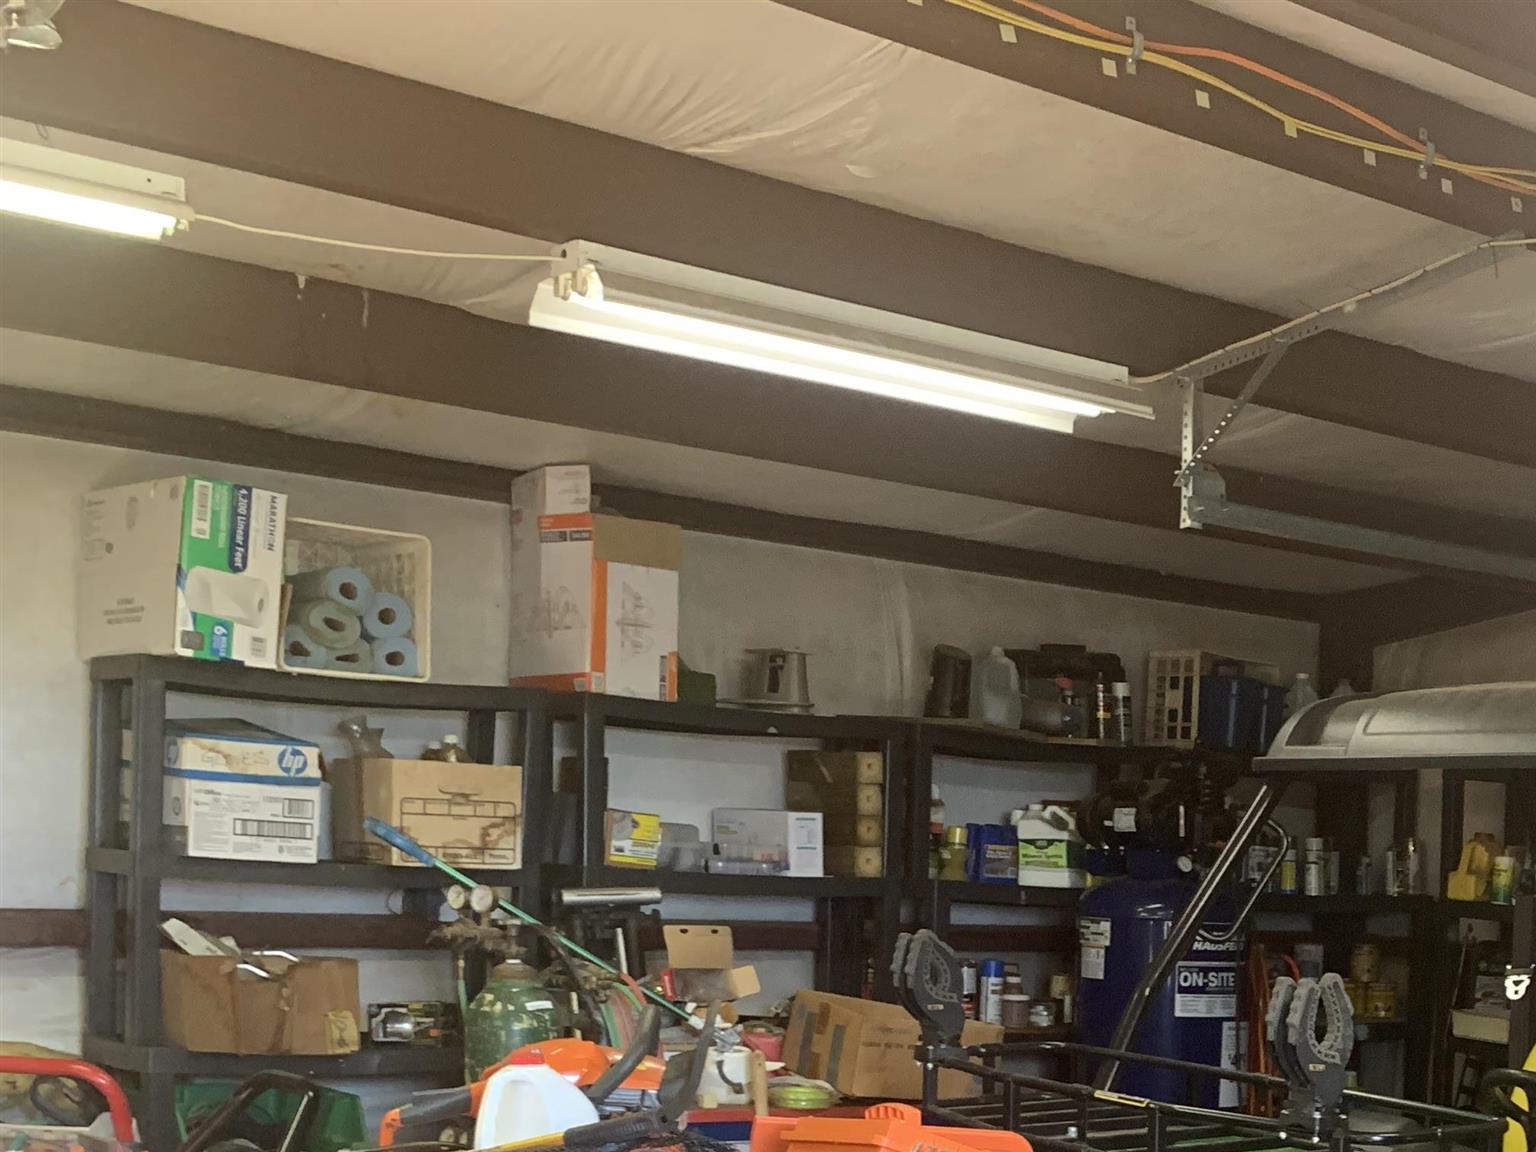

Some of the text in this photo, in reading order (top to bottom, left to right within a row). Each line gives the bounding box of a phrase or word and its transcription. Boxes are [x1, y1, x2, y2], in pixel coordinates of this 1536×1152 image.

[233, 488, 250, 569] 4,200 Linear Feet
[214, 625, 227, 636] 6
[281, 746, 305, 777] hp
[1179, 971, 1236, 987] ON-SITE
